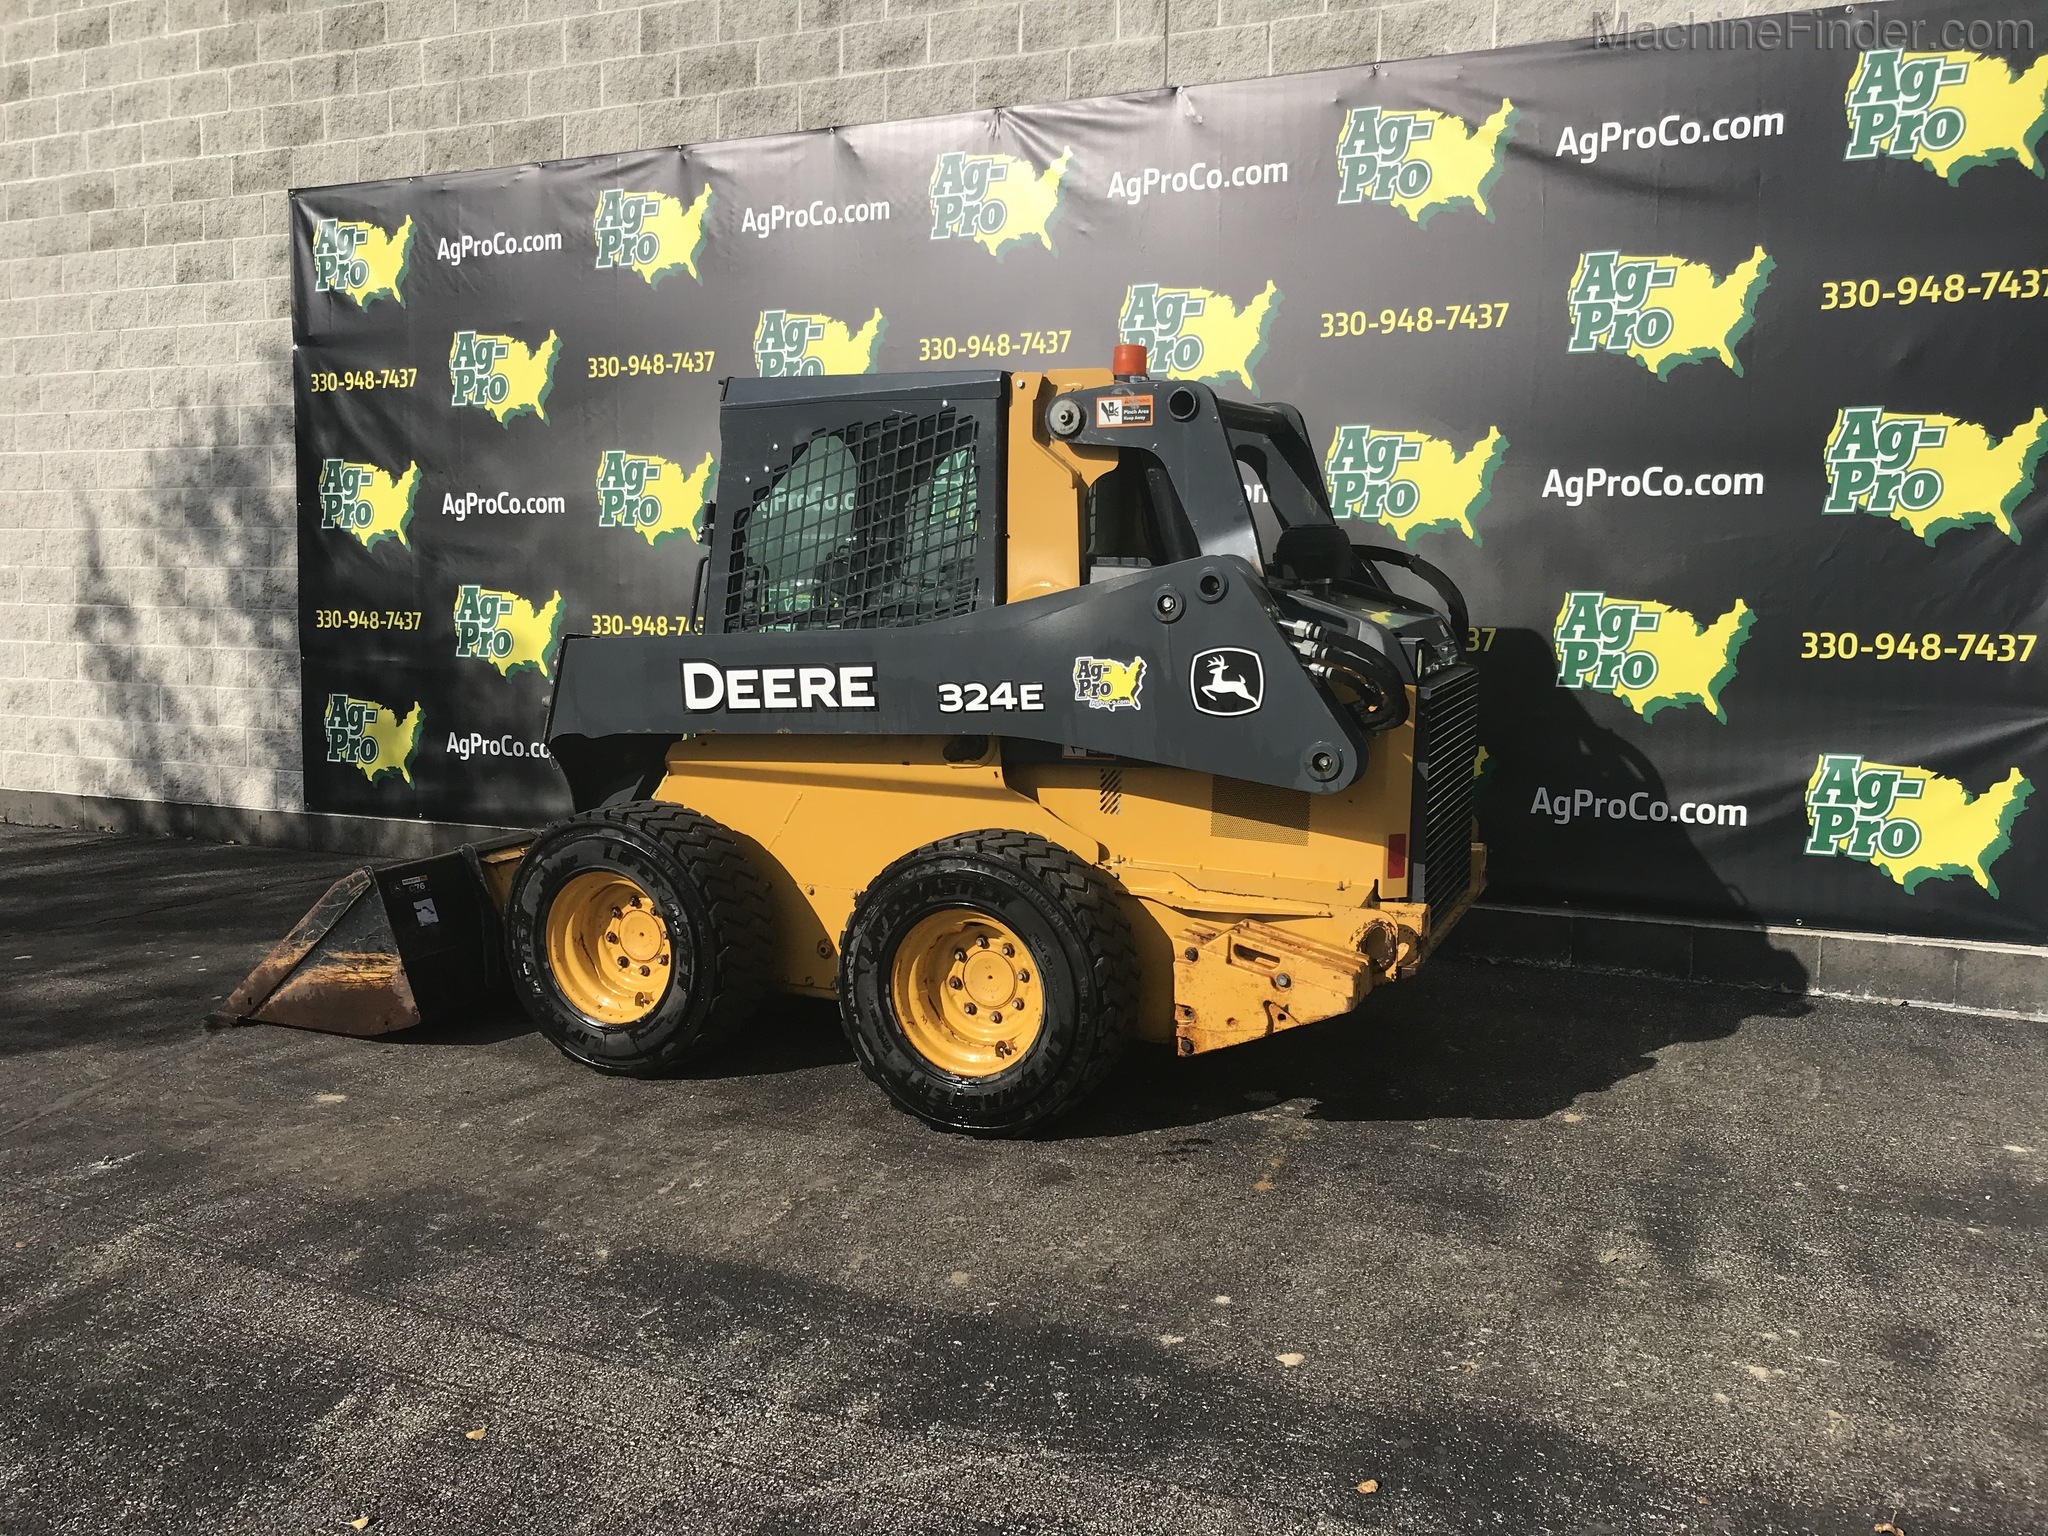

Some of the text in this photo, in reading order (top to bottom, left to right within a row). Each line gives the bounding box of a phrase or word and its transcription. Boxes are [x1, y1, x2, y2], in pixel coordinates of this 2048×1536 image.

[1850, 48, 1969, 109] Ag-
[1339, 107, 1433, 162] Ag-
[1555, 112, 1784, 163] AgProCo.com
[1844, 101, 1966, 160] Pro
[932, 152, 1008, 198] Ag-
[1107, 162, 1288, 205] AgProCo.com
[1337, 155, 1431, 204] Pro
[596, 190, 658, 232] Ag-
[742, 199, 890, 238] AgProCo.com
[931, 195, 1006, 240] Pro
[316, 219, 367, 261] Ag-
[437, 232, 562, 265] AgProCo.com
[595, 229, 659, 268] Pro
[316, 259, 368, 292] Pro
[1572, 251, 1677, 307] Ag-
[1121, 284, 1204, 337] Ag-
[1320, 303, 1509, 338] 330-948-7437
[1567, 300, 1674, 353] Pro
[451, 331, 506, 374] Ag-
[756, 310, 823, 358] Ag-
[919, 331, 1071, 362] 330-948-7437
[311, 369, 417, 392] 330-948-7437
[588, 351, 715, 378] 330-948-7437
[452, 369, 508, 406] Pro
[1328, 425, 1420, 481] Ag-
[1827, 407, 1947, 461] Ag-
[320, 458, 372, 498] Ag-
[599, 451, 659, 495] Ag-
[1542, 467, 1764, 506] AgProCo.com
[1822, 457, 1944, 514] Pro
[321, 493, 373, 529] Pro
[442, 491, 565, 521] AgProCo.com
[599, 490, 661, 527] Pro
[1331, 471, 1419, 518] Pro
[316, 610, 421, 630] 330-948-7437
[456, 585, 512, 629] Ag-
[592, 614, 705, 636] 330-948-7
[1556, 591, 1661, 649] Ag-
[456, 624, 513, 658] Pro
[1800, 632, 2037, 662] 330-948-7437
[682, 661, 877, 710] DEERE
[1077, 659, 1111, 682] Ag-
[1556, 641, 1658, 688] Pro
[938, 683, 1044, 713] 324E
[1077, 679, 1112, 698] Pro
[327, 695, 377, 733] Ag-
[327, 729, 378, 762] Pro
[446, 732, 551, 760] AgProCo.co
[1812, 754, 1927, 812] Ag-
[1530, 788, 1747, 827] AgProCo.com
[1804, 804, 1922, 857] Pro
